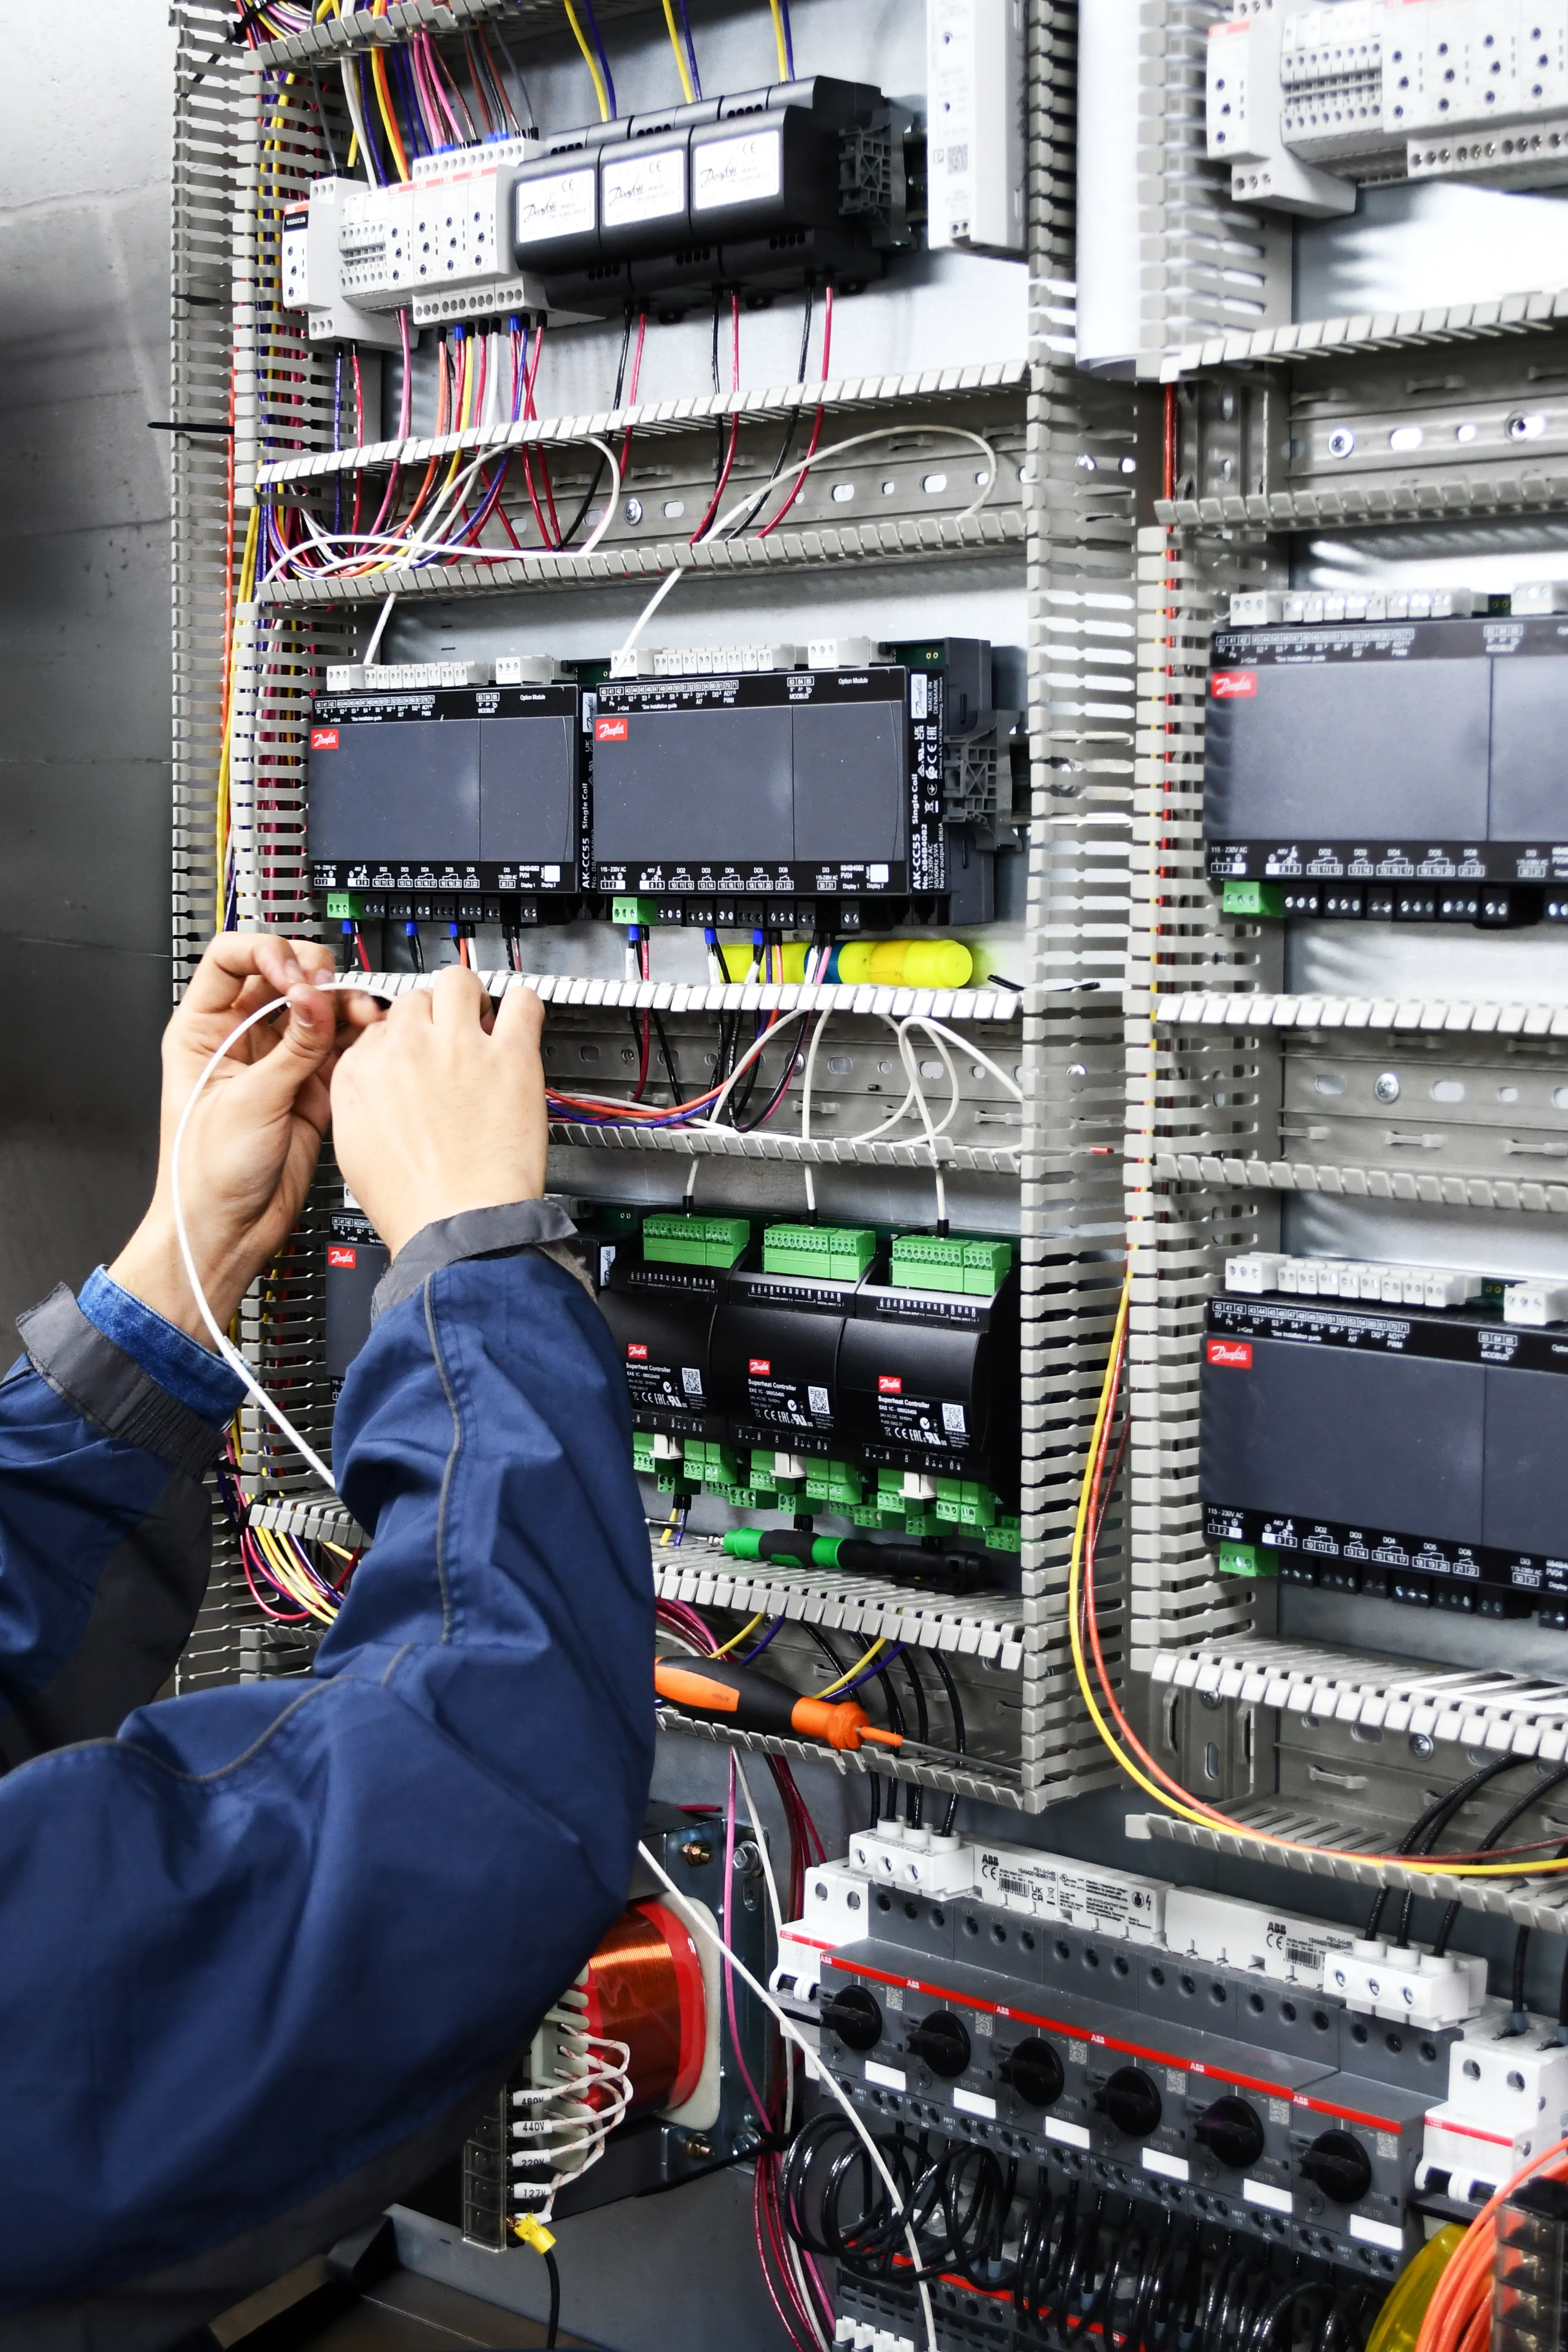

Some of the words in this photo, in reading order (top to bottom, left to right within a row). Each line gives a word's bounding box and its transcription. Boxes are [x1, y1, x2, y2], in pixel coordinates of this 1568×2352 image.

[562, 179, 573, 192] CE
[1216, 676, 1251, 695] Danfoss
[916, 678, 924, 715] Danfoss
[599, 721, 624, 738] Danfoss
[914, 726, 919, 740] UK
[919, 725, 924, 740] CA
[314, 732, 336, 746] Danfoss
[927, 744, 937, 764] CE
[928, 843, 933, 854] AC
[912, 833, 921, 889] AK-CC55
[629, 1347, 646, 1355] Danfoss
[1211, 1345, 1247, 1361] Danfoss
[751, 1361, 769, 1371] Danfoss
[748, 1379, 772, 1388] Superheat
[773, 1382, 796, 1391] Controller
[880, 1379, 900, 1388] Danfoss
[642, 1392, 654, 1403] CE
[878, 1395, 904, 1405] Superheat
[904, 1399, 930, 1408] Controller
[764, 1409, 777, 1421] CE
[895, 1427, 908, 1439] CE
[982, 1854, 999, 1866] ABB
[982, 1865, 996, 1880] CE
[1032, 1886, 1043, 1895] UK
[1032, 1893, 1043, 1902] CA
[1267, 1922, 1286, 1935] ABB
[1267, 1933, 1283, 1950] CE
[820, 1955, 832, 1964] ABB
[907, 1979, 919, 1988] ABB
[996, 2006, 1009, 2015] ABB
[1091, 2034, 1105, 2044] ABB
[872, 2051, 892, 2064] MS116
[1190, 2063, 1204, 2072] ABB
[961, 2078, 981, 2091] MS116
[521, 2097, 544, 2106] 480V
[1293, 2095, 1308, 2105] ABB
[523, 2121, 544, 2132] 440V
[1150, 2138, 1173, 2152] MS116
[521, 2158, 544, 2166] 220V
[524, 2189, 546, 2197] 127V
